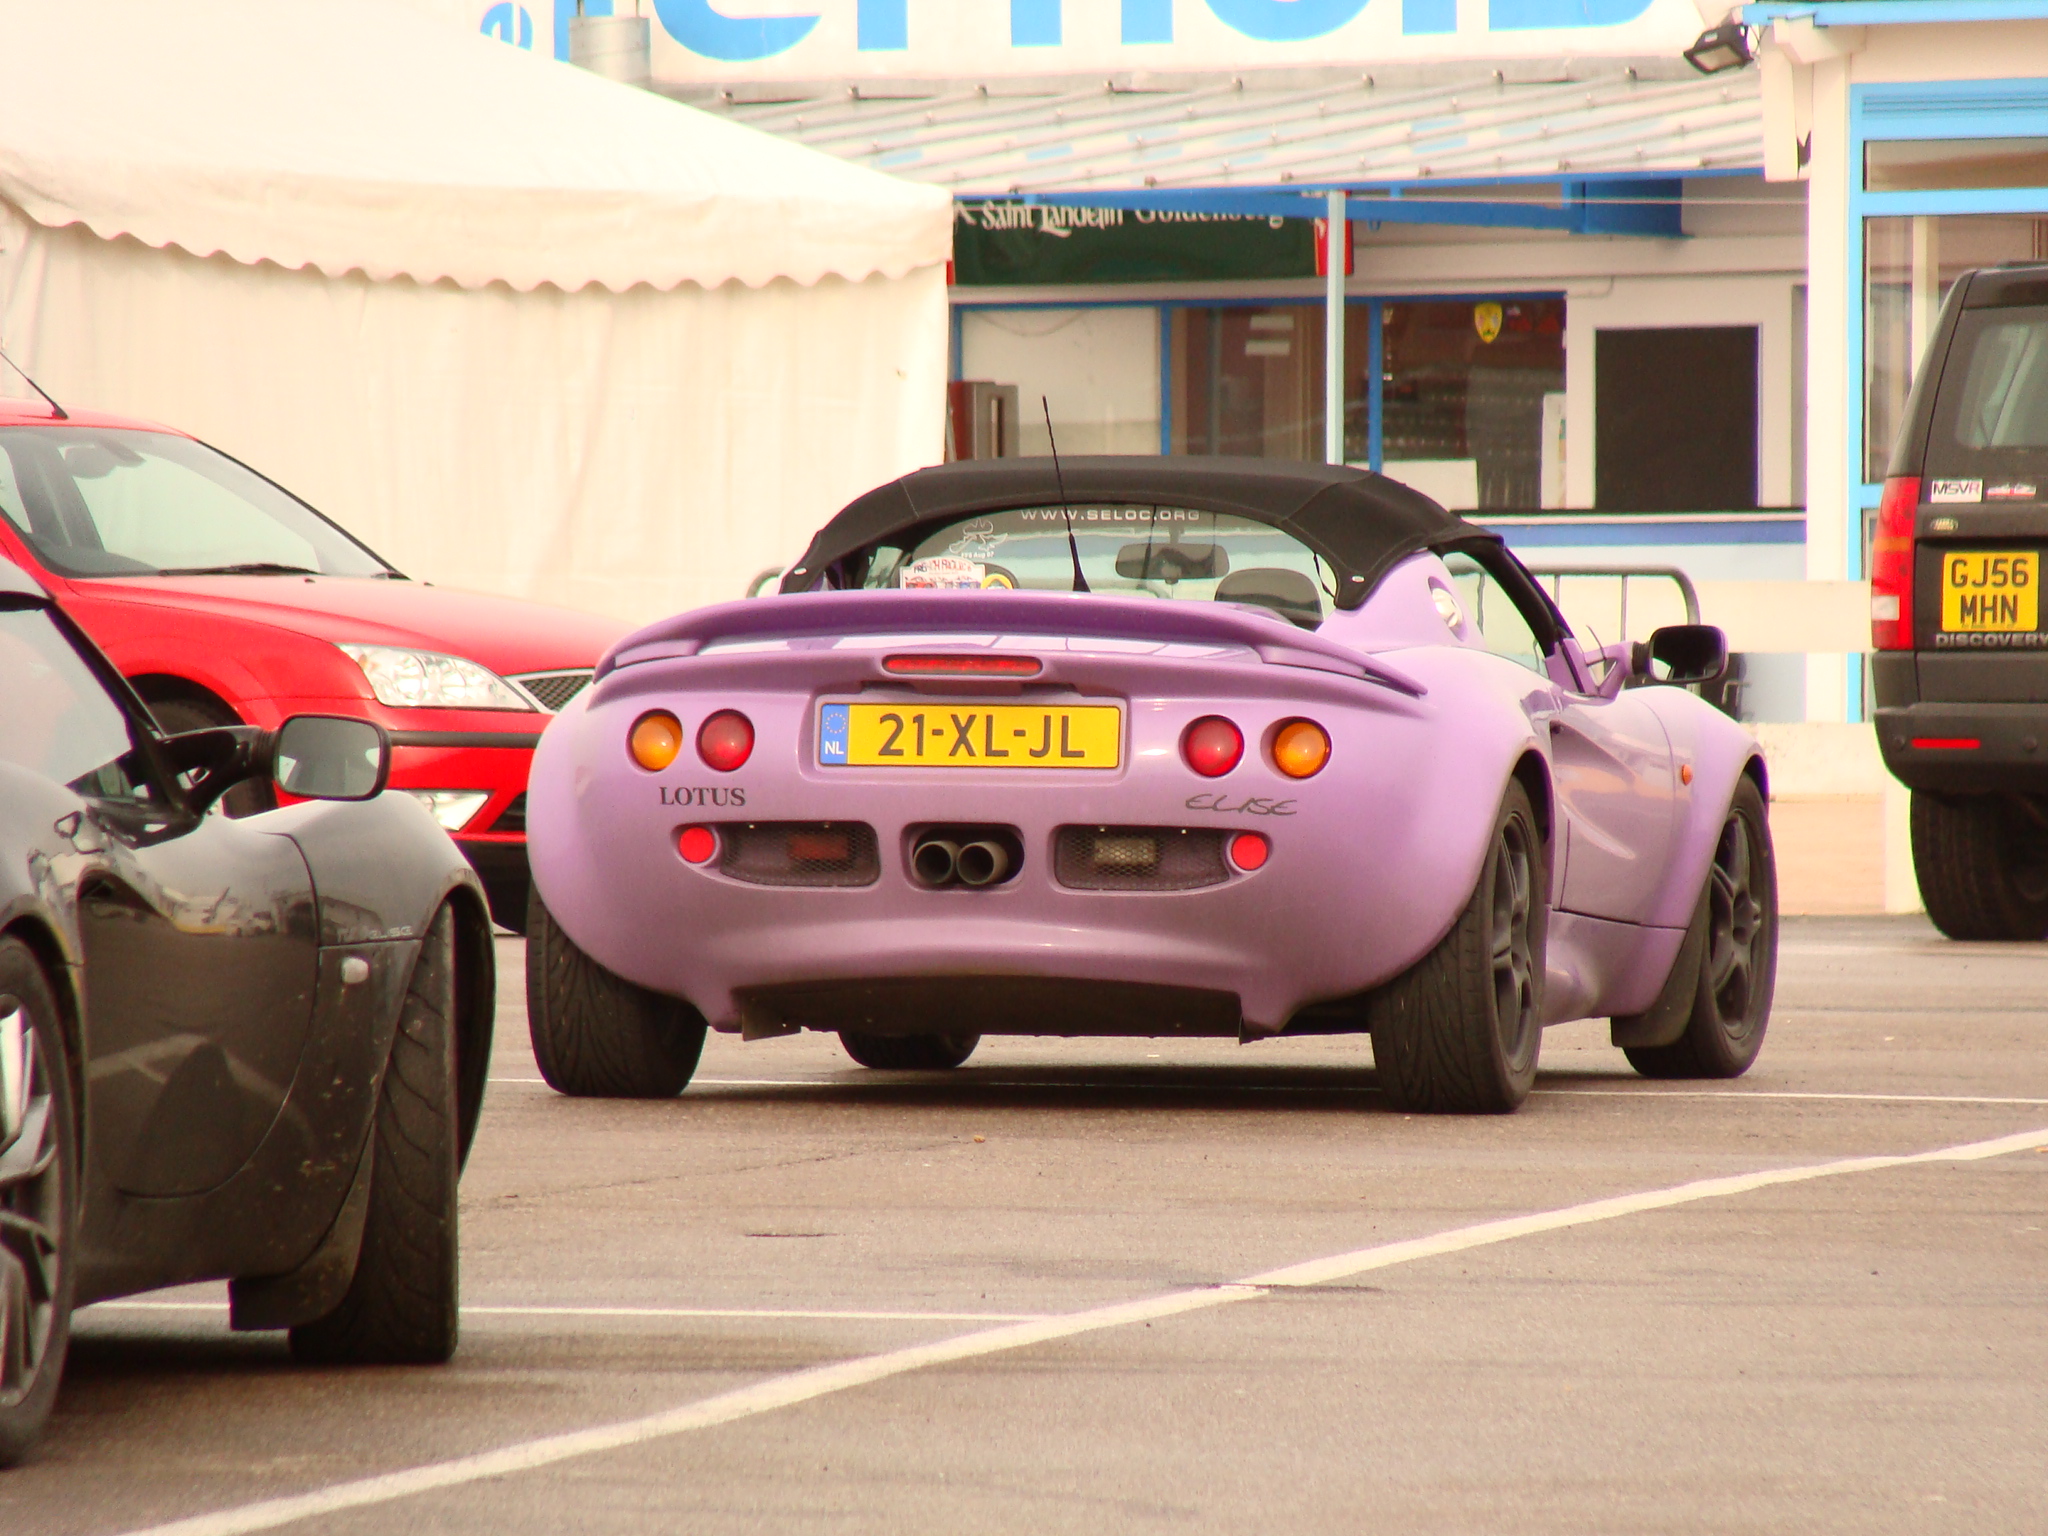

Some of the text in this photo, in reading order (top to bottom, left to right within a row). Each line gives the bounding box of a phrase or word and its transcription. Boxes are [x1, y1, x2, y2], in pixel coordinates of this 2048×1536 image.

[982, 200, 1034, 230] Saint
[1933, 483, 1980, 496] MSVR
[1020, 509, 1200, 521] WWW.SELOC.ORG
[1951, 558, 2029, 588] GJ56
[1960, 594, 2018, 625] MHN
[1935, 633, 2048, 648] DISCOVERY
[878, 713, 1086, 758] 21-XL-JL
[824, 741, 844, 754] NL
[659, 786, 746, 807] LOTUS
[1185, 793, 1298, 816] ELISE
